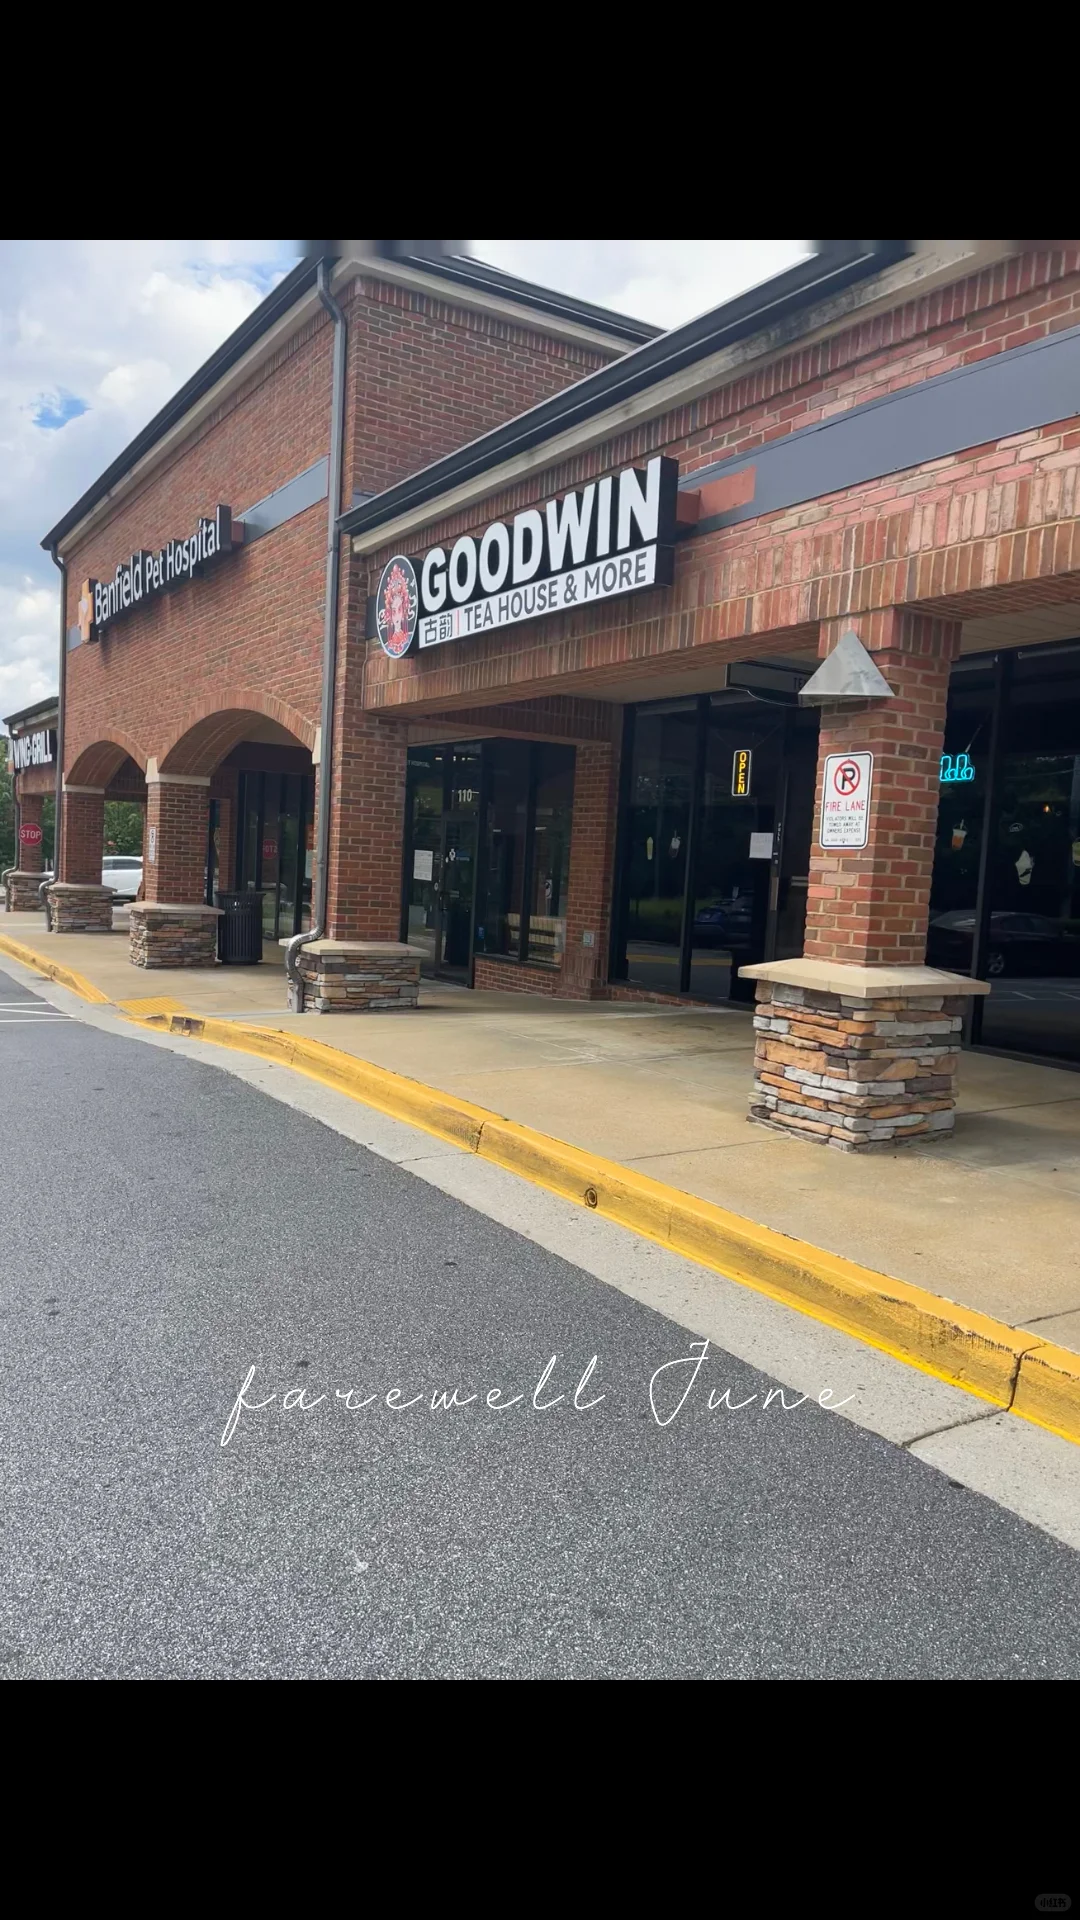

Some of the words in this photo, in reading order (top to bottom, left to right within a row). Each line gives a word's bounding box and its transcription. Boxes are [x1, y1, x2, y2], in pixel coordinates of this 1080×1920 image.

[421, 456, 662, 613] GOODWIN
[95, 549, 143, 625] Banfield
[146, 550, 164, 593] Pet
[166, 505, 221, 580] Hospital
[464, 602, 493, 632] TEA
[498, 580, 558, 623] HOUSE
[563, 574, 578, 604] &
[584, 551, 647, 599] MORE
[737, 752, 747, 794] OPEN
[457, 788, 473, 803] 110
[825, 801, 841, 812] FIRE
[845, 800, 865, 812] LANE
[20, 829, 42, 839] STOP
